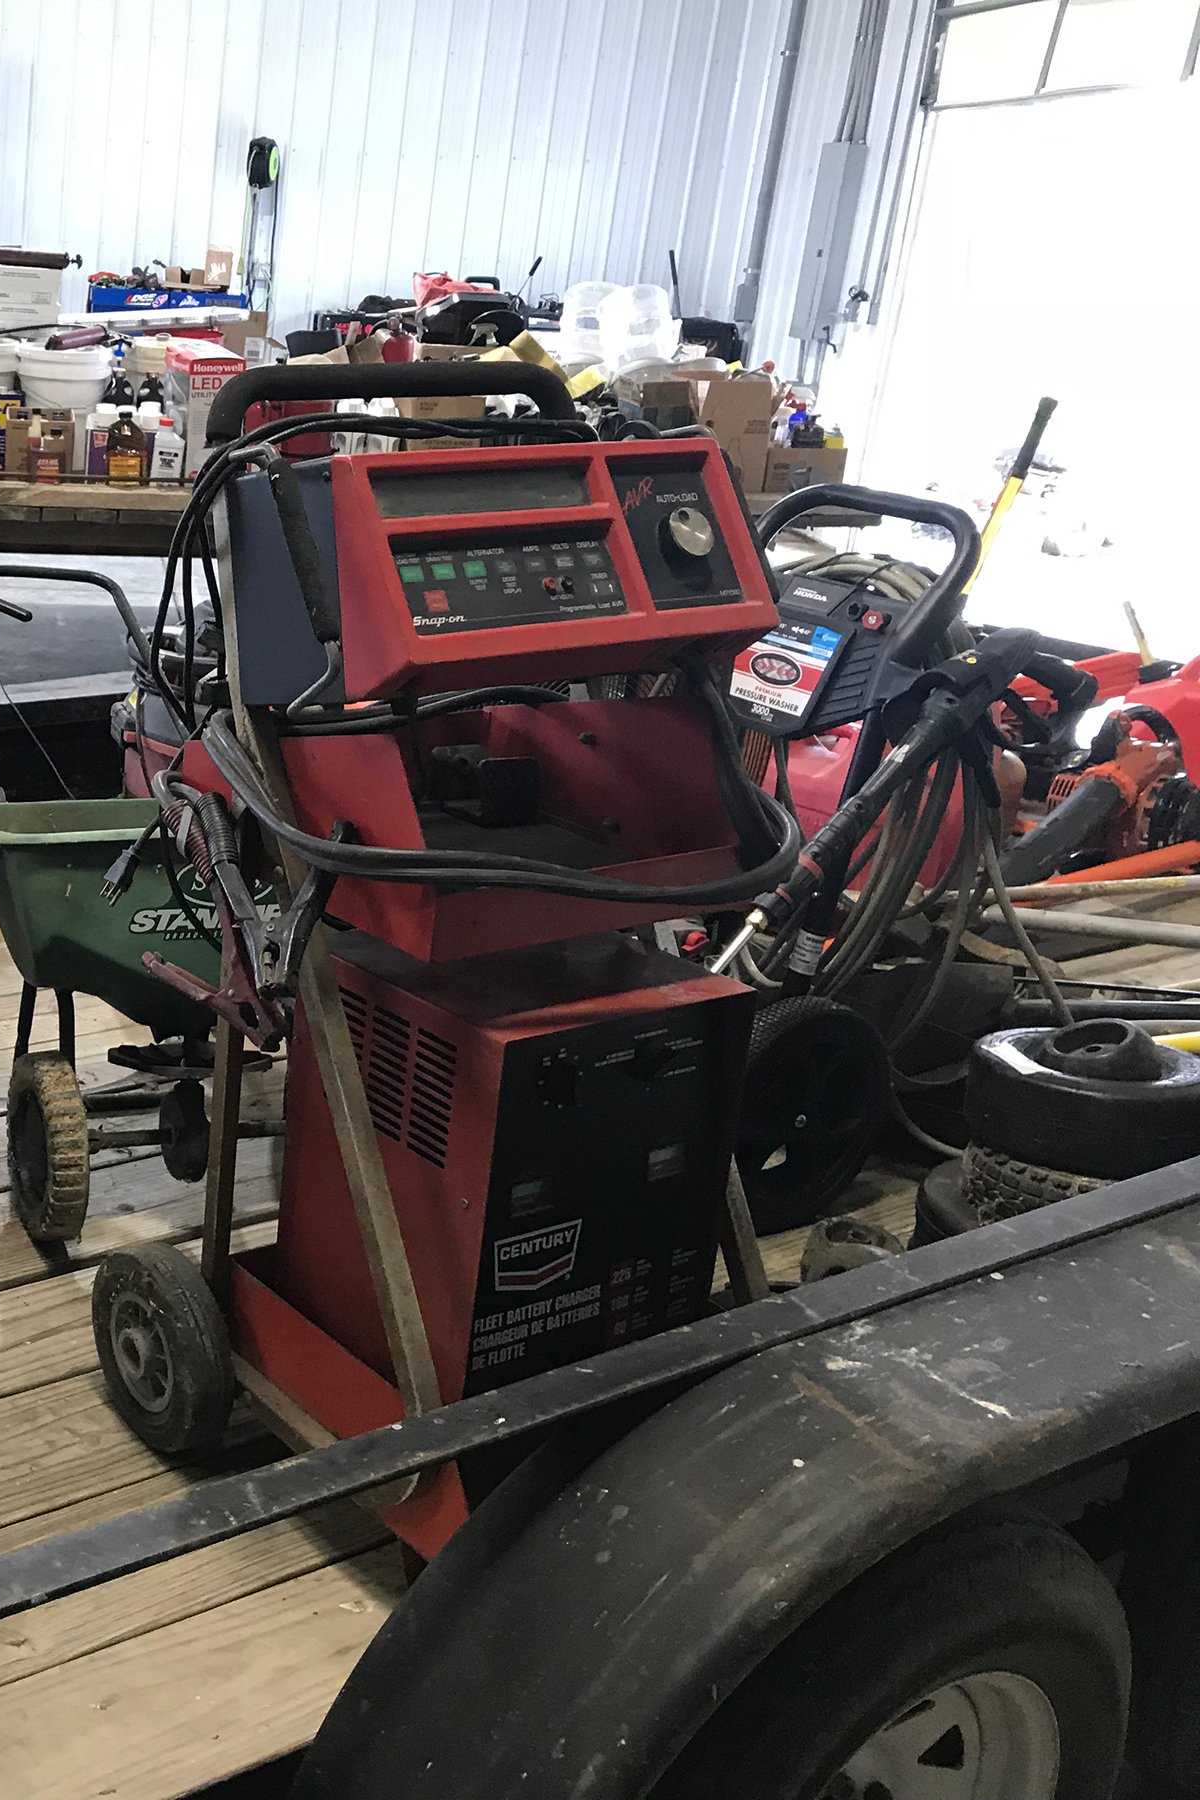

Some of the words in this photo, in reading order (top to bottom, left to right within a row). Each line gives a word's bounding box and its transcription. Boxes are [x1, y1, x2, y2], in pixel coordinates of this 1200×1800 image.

[193, 363, 244, 374] Honeywell
[191, 377, 223, 390] LED
[622, 476, 654, 515] AVR
[656, 492, 699, 503] AUTO-LOAD
[466, 548, 505, 557] ALTERNATOR
[550, 543, 570, 551] VOLTS
[793, 588, 828, 601] HONDA
[413, 614, 467, 627] Snap-on
[755, 685, 783, 698] PREMIUM
[734, 686, 768, 703] PRESSURE
[769, 695, 800, 714] WASHER
[751, 704, 771, 717] 3000
[500, 1229, 576, 1261] CENTURY
[474, 1312, 505, 1333] FLEET
[507, 1299, 553, 1325] BATTERY
[555, 1285, 601, 1311] CHARGER
[473, 1324, 529, 1353] CHARGEUR
[531, 1321, 544, 1335] DE
[547, 1302, 601, 1331] BATTERIES
[472, 1354, 487, 1371] DE
[488, 1341, 526, 1366] FLOTTE
